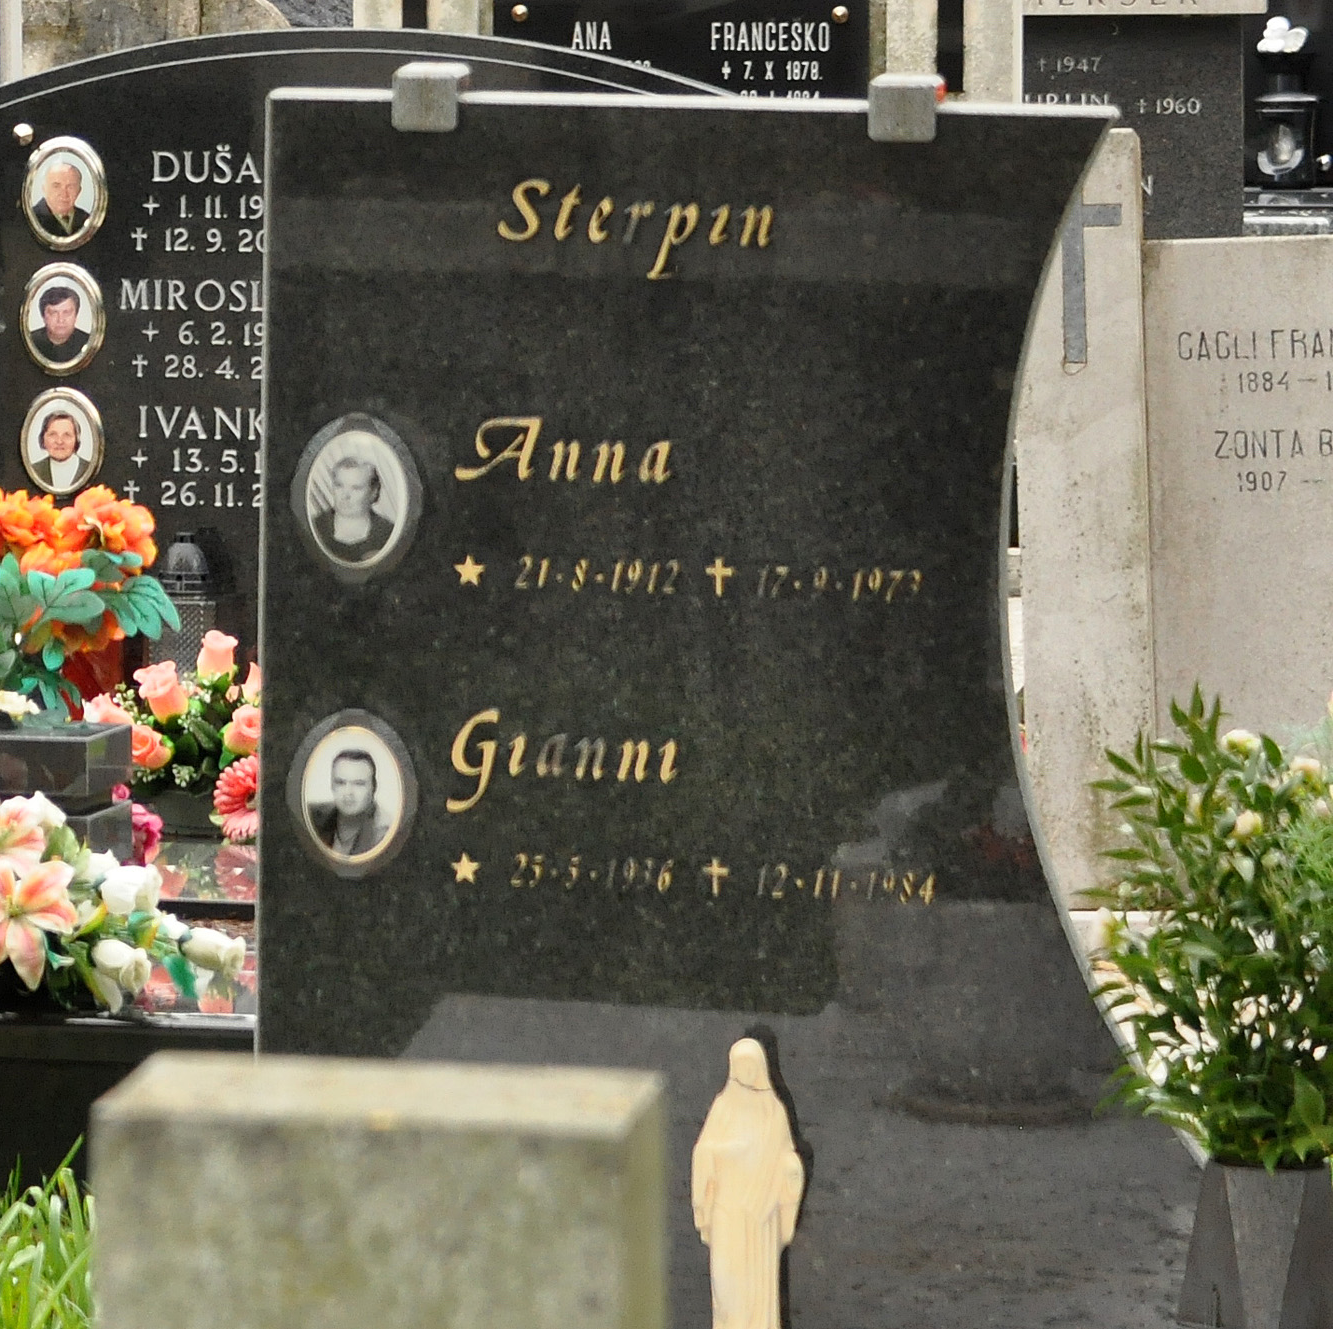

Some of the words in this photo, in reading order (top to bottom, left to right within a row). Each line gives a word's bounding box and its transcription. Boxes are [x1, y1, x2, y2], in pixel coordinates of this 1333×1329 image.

[571, 21, 612, 50] ANA
[710, 22, 830, 52] FRANCESKO
[764, 61, 774, 80] X
[1056, 56, 1103, 72] 1947
[1156, 97, 1201, 115] 1960
[204, 194, 228, 219] 11.
[165, 227, 196, 252] 12.
[205, 228, 227, 252] 9.
[497, 178, 773, 280] Sterpin
[178, 321, 200, 345] 6.
[210, 322, 233, 345] 2.
[1271, 329, 1333, 359] FRA
[164, 354, 204, 378] 28.
[214, 355, 240, 379] 4.
[1238, 371, 1289, 393] 1884
[454, 415, 673, 484] Anna
[1214, 430, 1304, 459] ZONTA
[172, 447, 210, 473] 13.
[220, 449, 245, 473] 5.
[160, 481, 205, 507] 26.
[214, 482, 243, 507] 11.
[1237, 471, 1287, 492] 1907
[446, 707, 679, 813] Gianni
